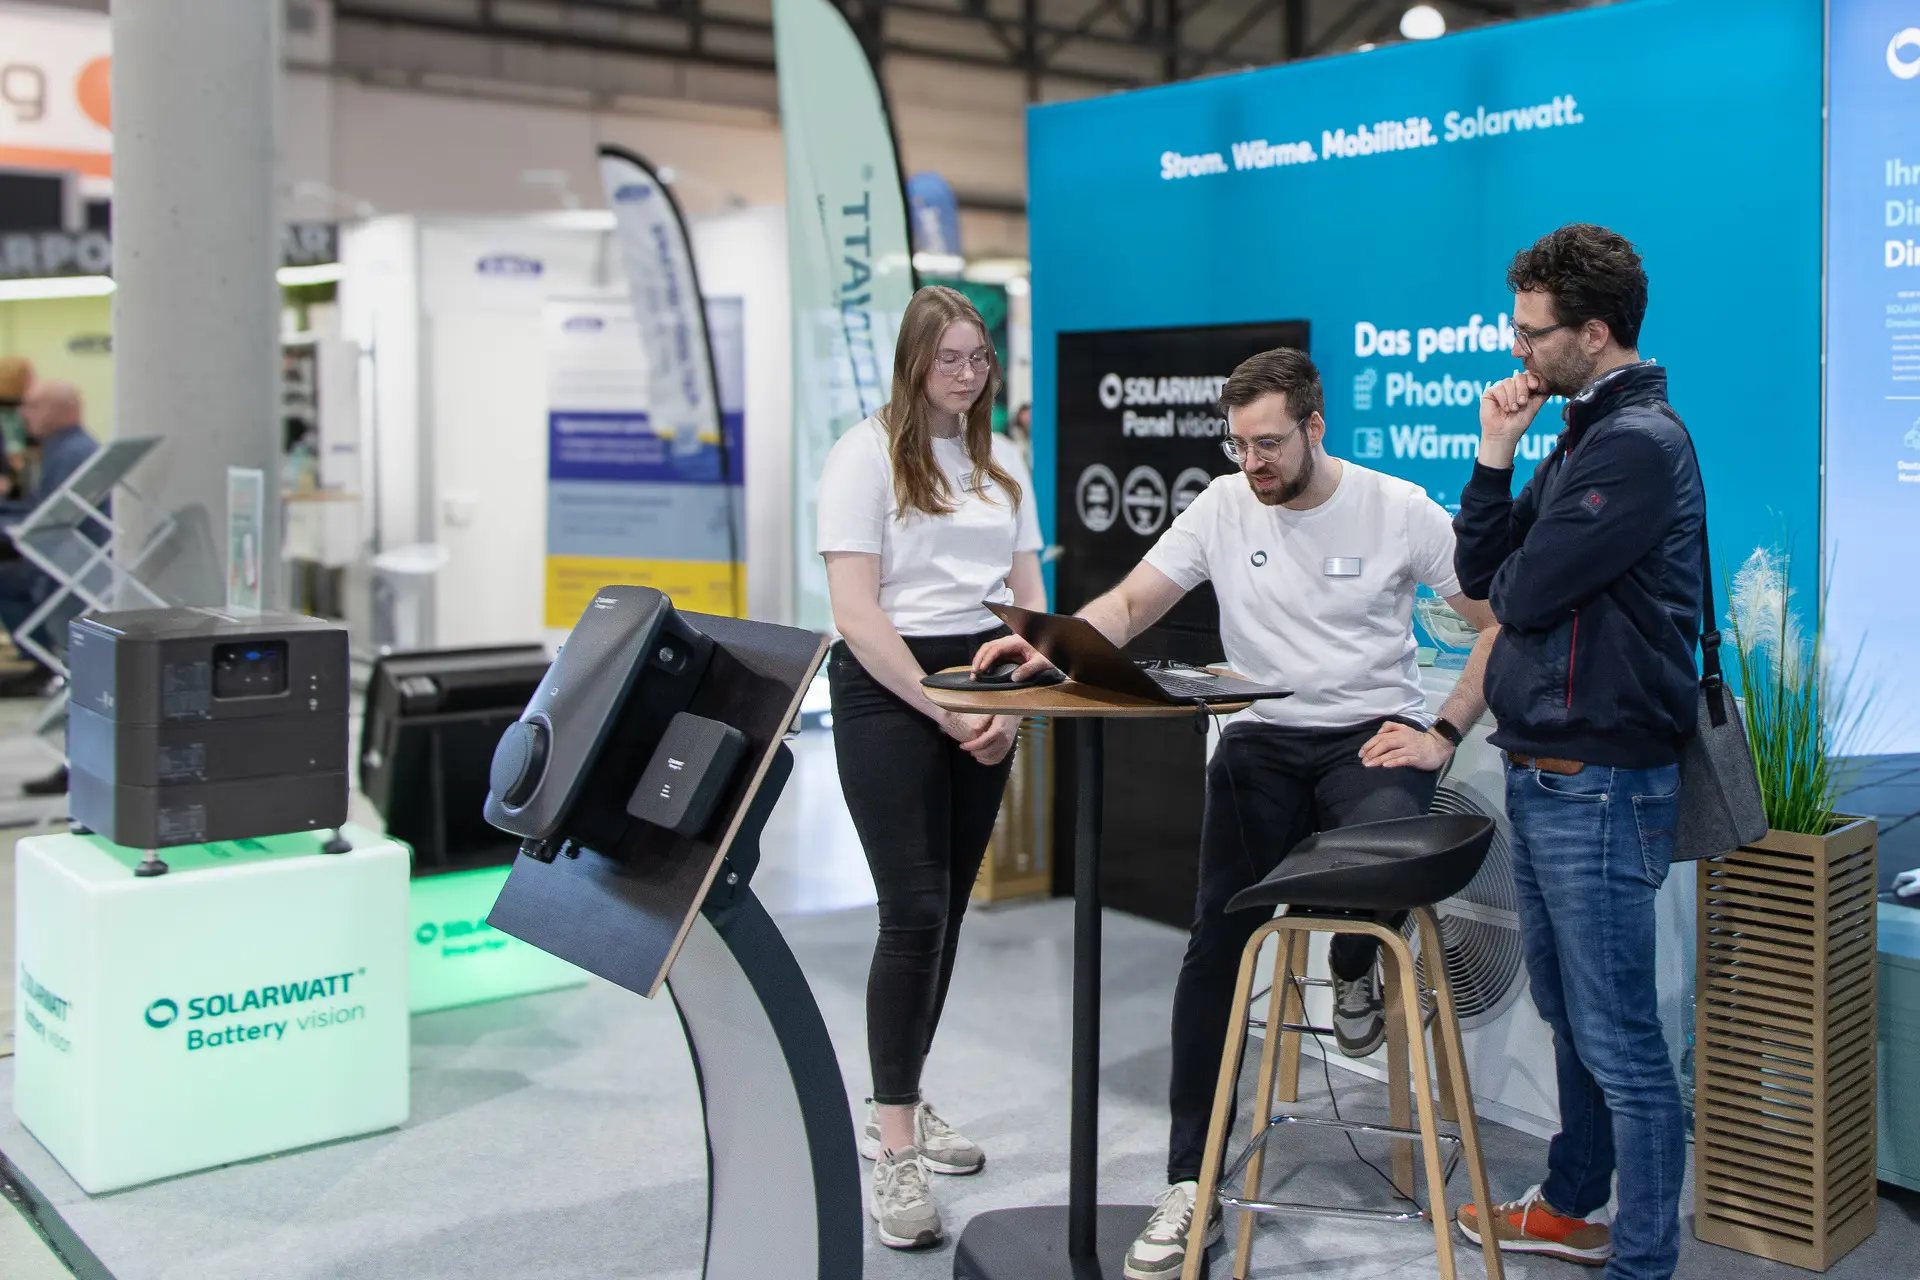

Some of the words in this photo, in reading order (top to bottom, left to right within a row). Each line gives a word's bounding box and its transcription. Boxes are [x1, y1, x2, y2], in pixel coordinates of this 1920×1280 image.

[1160, 149, 1228, 180] Strom.
[1232, 137, 1318, 171] Wärme.
[1321, 115, 1438, 161] Mobilität.
[1443, 93, 1584, 142] Solarwatt.
[1354, 320, 1411, 358] Das
[1122, 409, 1175, 437] Panel
[187, 1018, 288, 1051] Battery
[296, 1003, 366, 1031] vision
